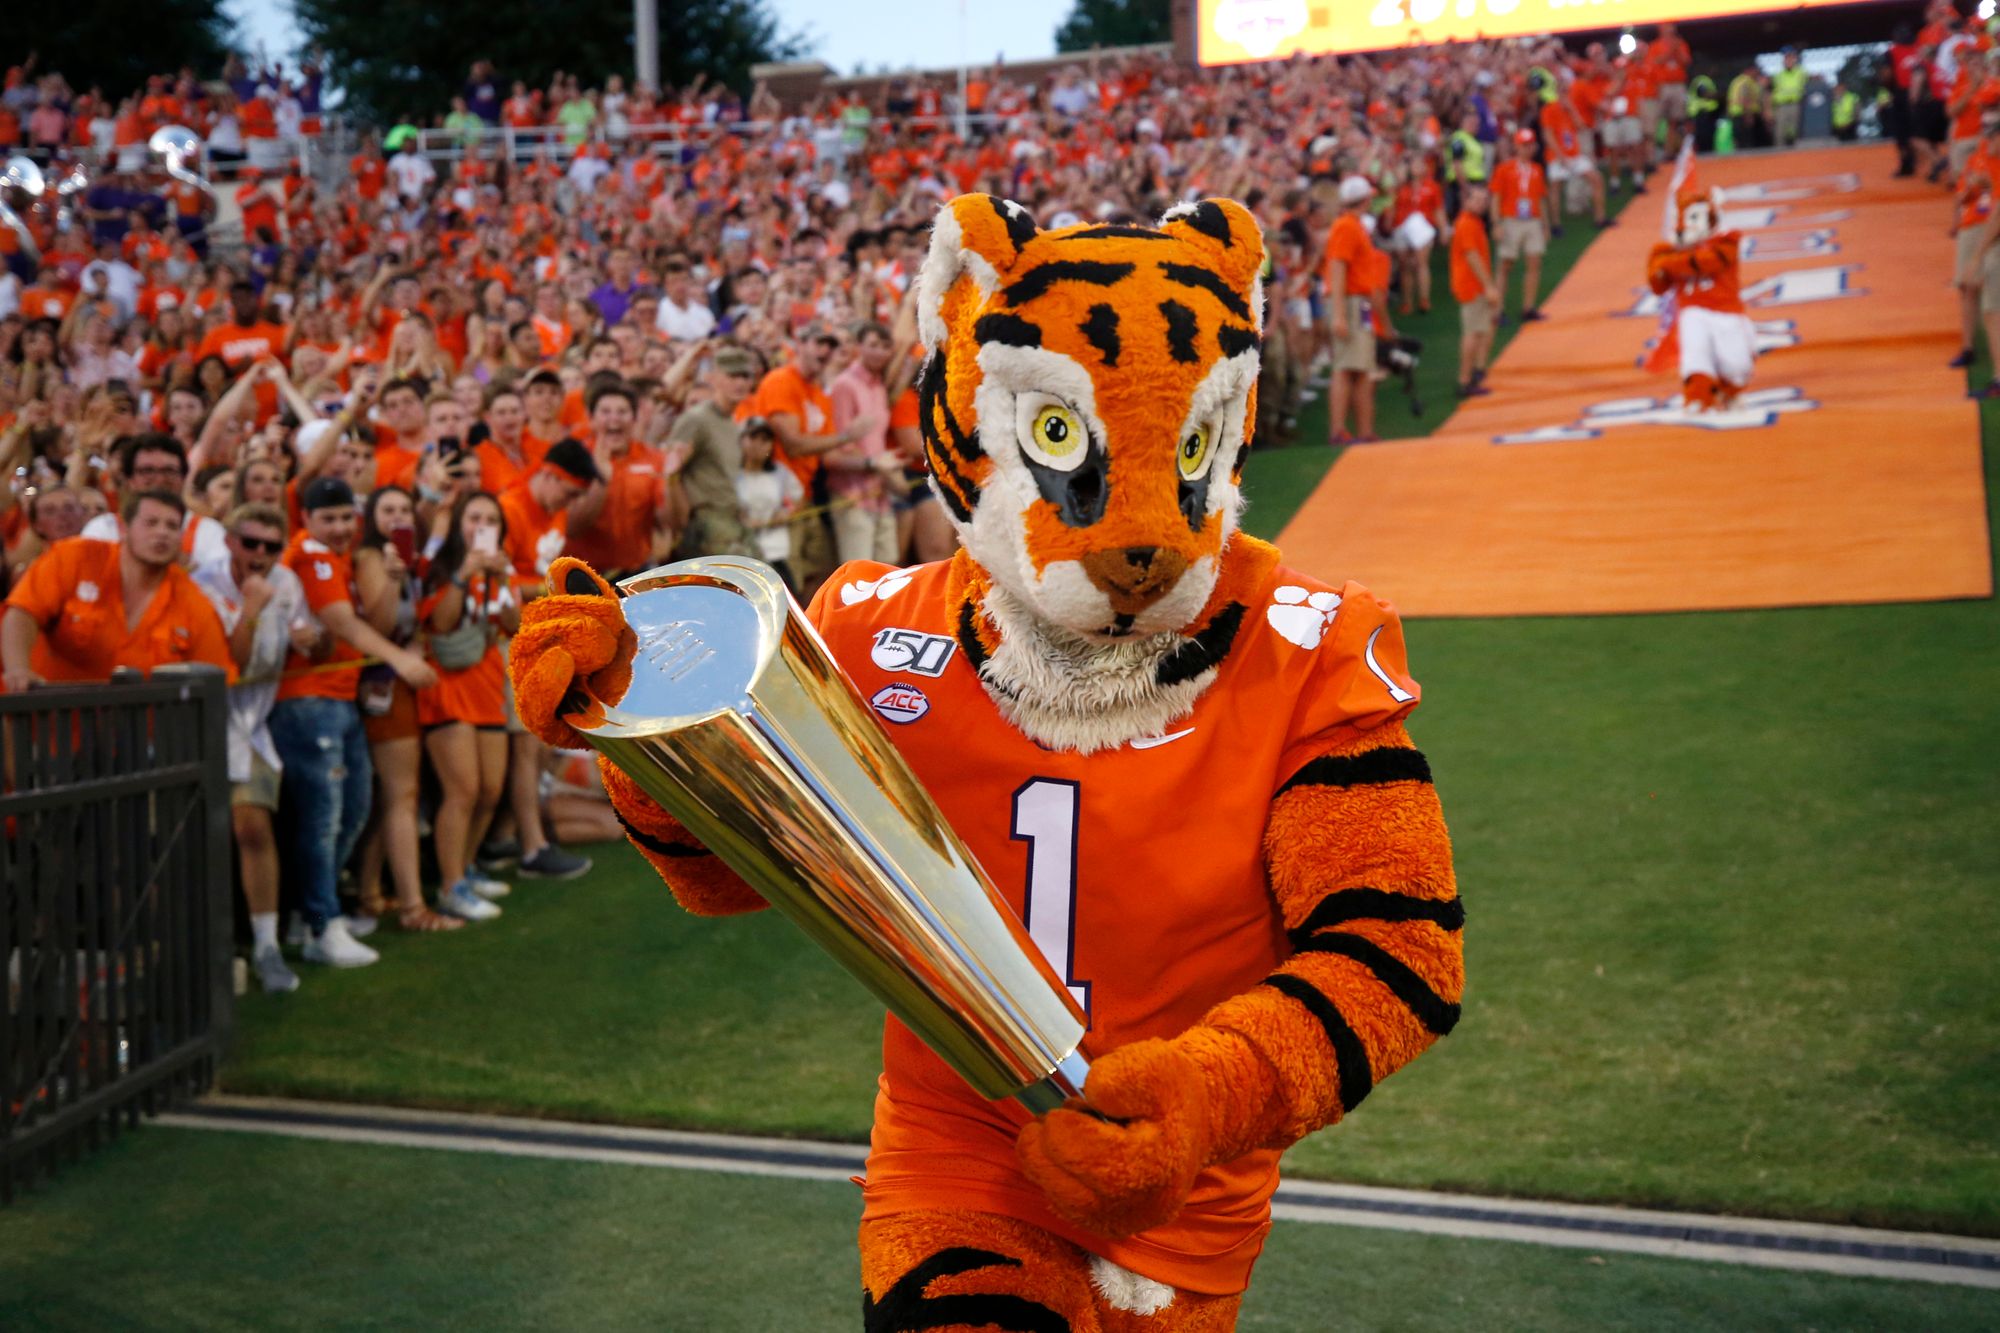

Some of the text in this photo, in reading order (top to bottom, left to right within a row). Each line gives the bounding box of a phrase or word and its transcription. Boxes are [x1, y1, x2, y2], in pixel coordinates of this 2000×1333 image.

[874, 629, 956, 675] 150
[879, 692, 924, 710] ACC
[1010, 776, 1092, 1032] 1
